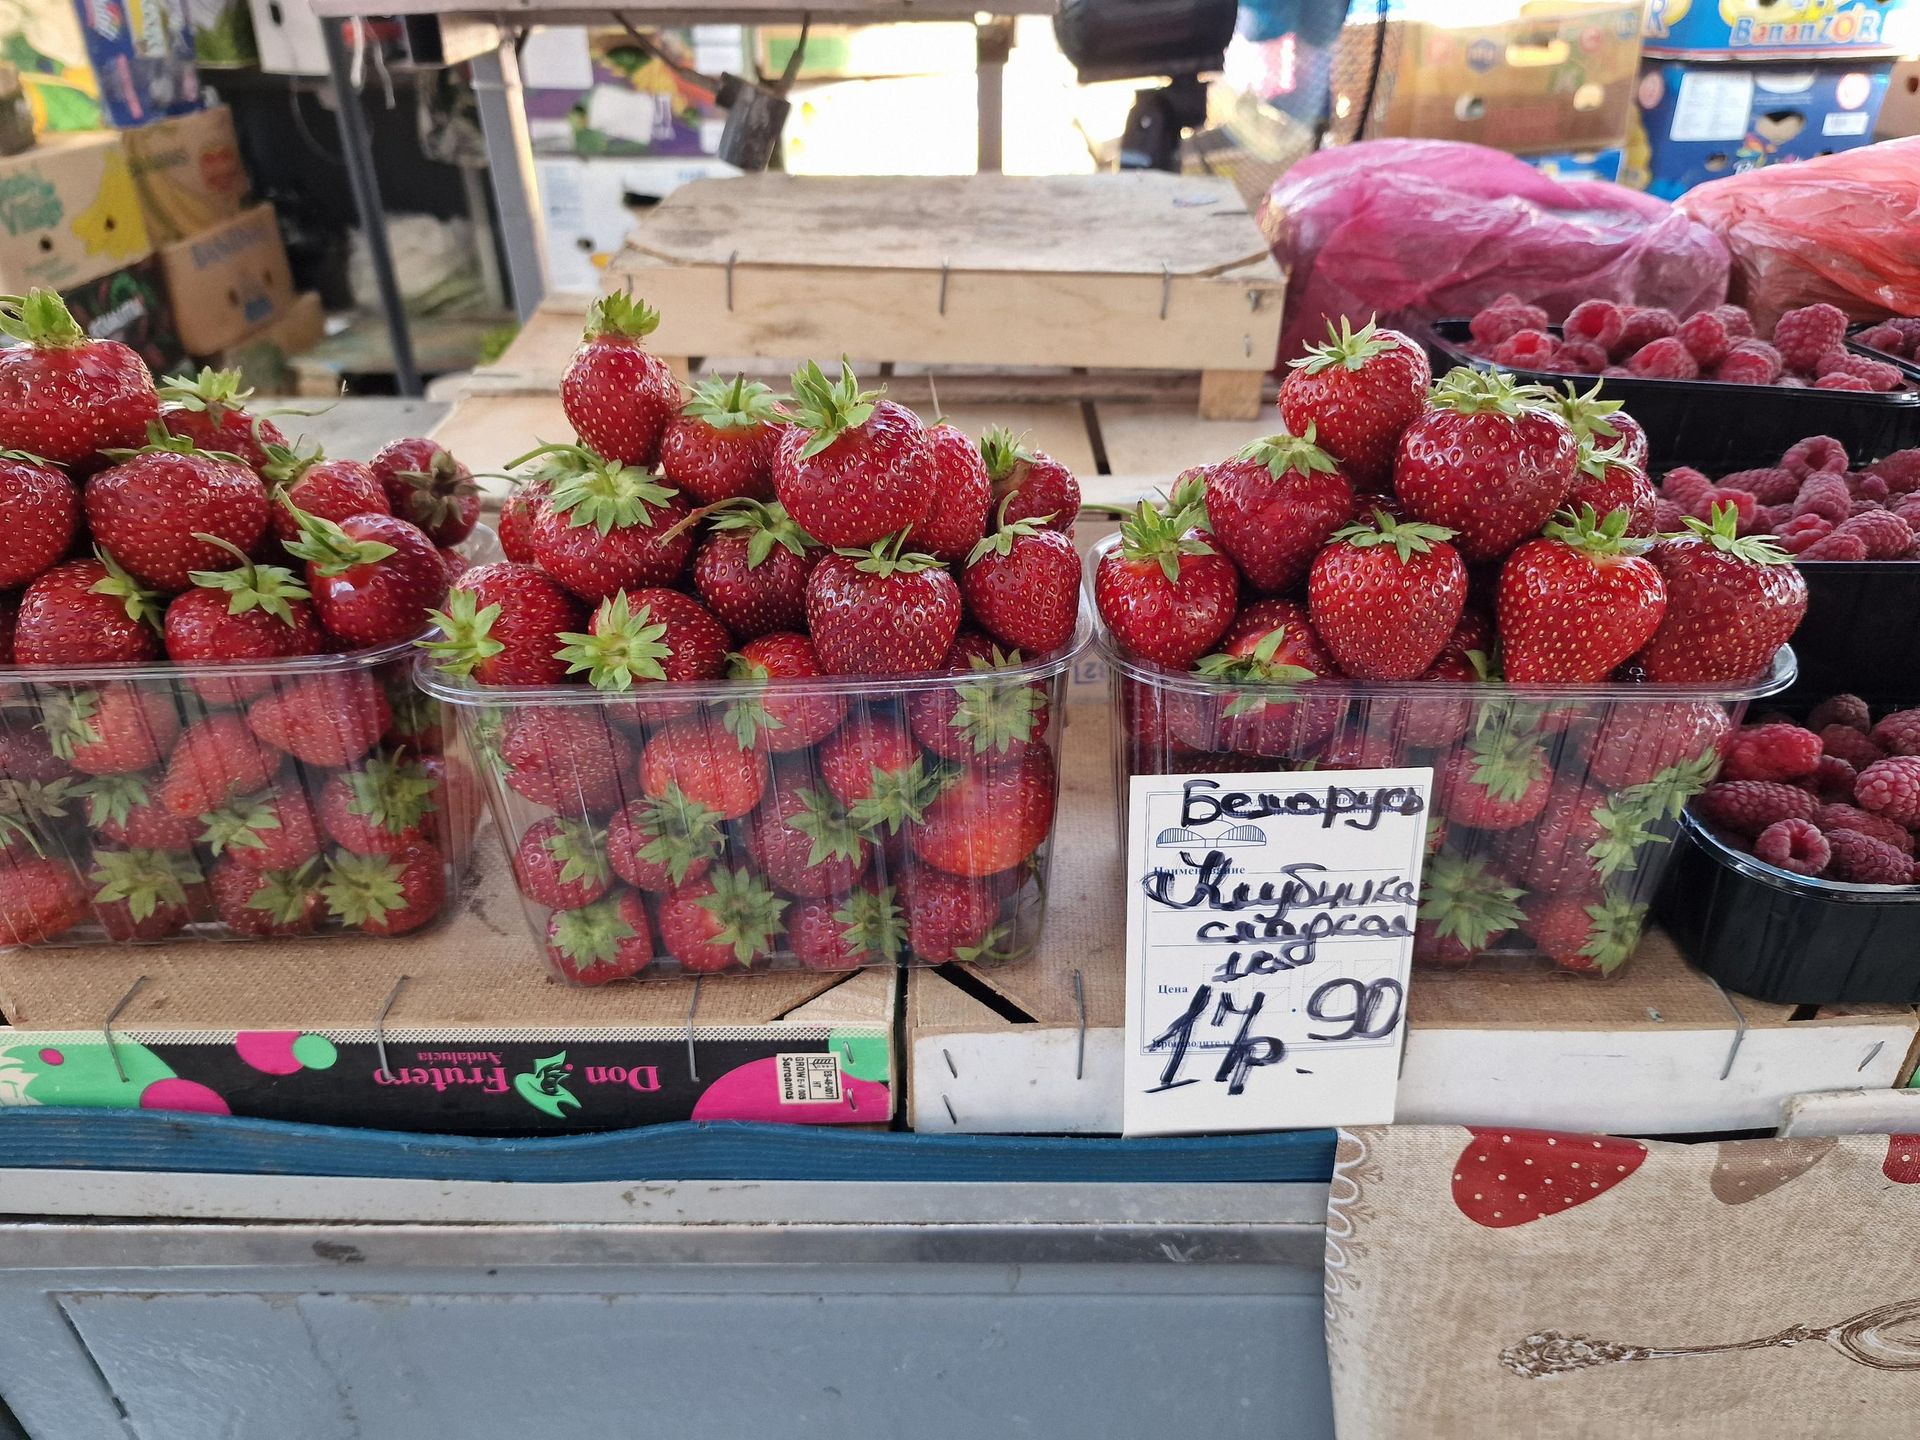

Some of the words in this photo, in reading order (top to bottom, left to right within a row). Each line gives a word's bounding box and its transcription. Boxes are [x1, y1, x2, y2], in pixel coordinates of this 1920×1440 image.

[1157, 984, 1189, 996] Цена
[373, 1066, 511, 1093] Frutero
[583, 1065, 662, 1092] Don
